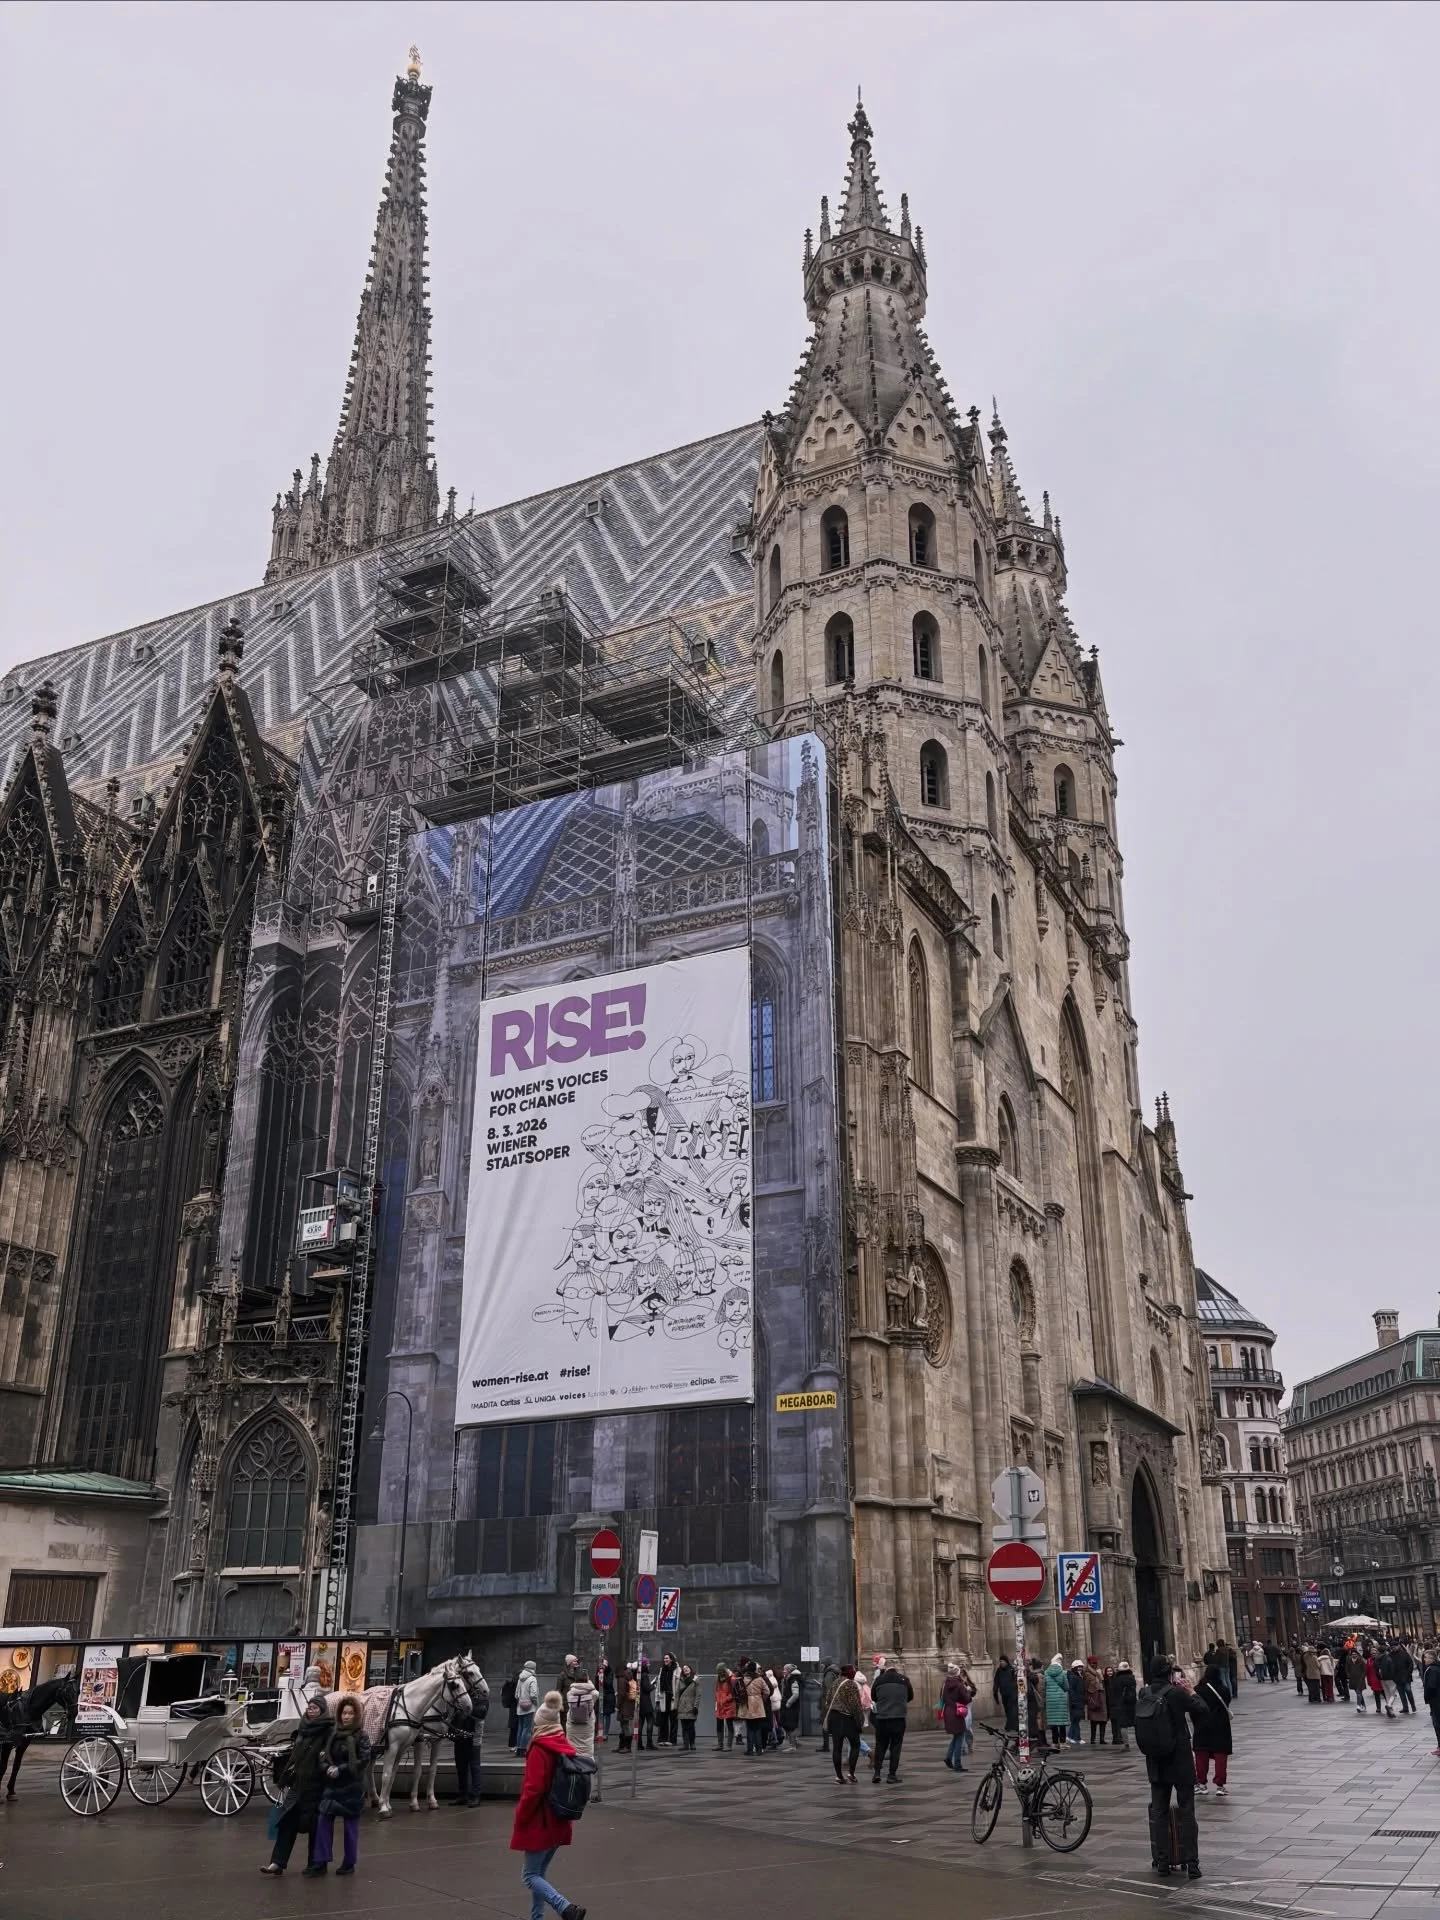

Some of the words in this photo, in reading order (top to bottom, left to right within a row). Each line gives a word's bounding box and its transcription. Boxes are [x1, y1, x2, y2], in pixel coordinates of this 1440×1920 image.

[490, 983, 647, 1077] RISE!
[490, 1079, 554, 1102] WOMEN'S
[557, 1069, 609, 1087] VOICES
[489, 1101, 517, 1118] FOR
[519, 1091, 576, 1111] CHANGE
[487, 1127, 500, 1140] 8.
[502, 1125, 514, 1138] 3.
[516, 1118, 548, 1135] 2026
[486, 1135, 538, 1156] WIENER
[486, 1145, 571, 1171] STAATSOPER
[472, 1370, 549, 1388] women-rise.at
[559, 1365, 591, 1378] #rise!
[559, 1391, 586, 1401] voices
[1082, 1582, 1095, 1594] 20
[1070, 1598, 1094, 1608] Zone
[278, 1643, 306, 1654] Mozart?
